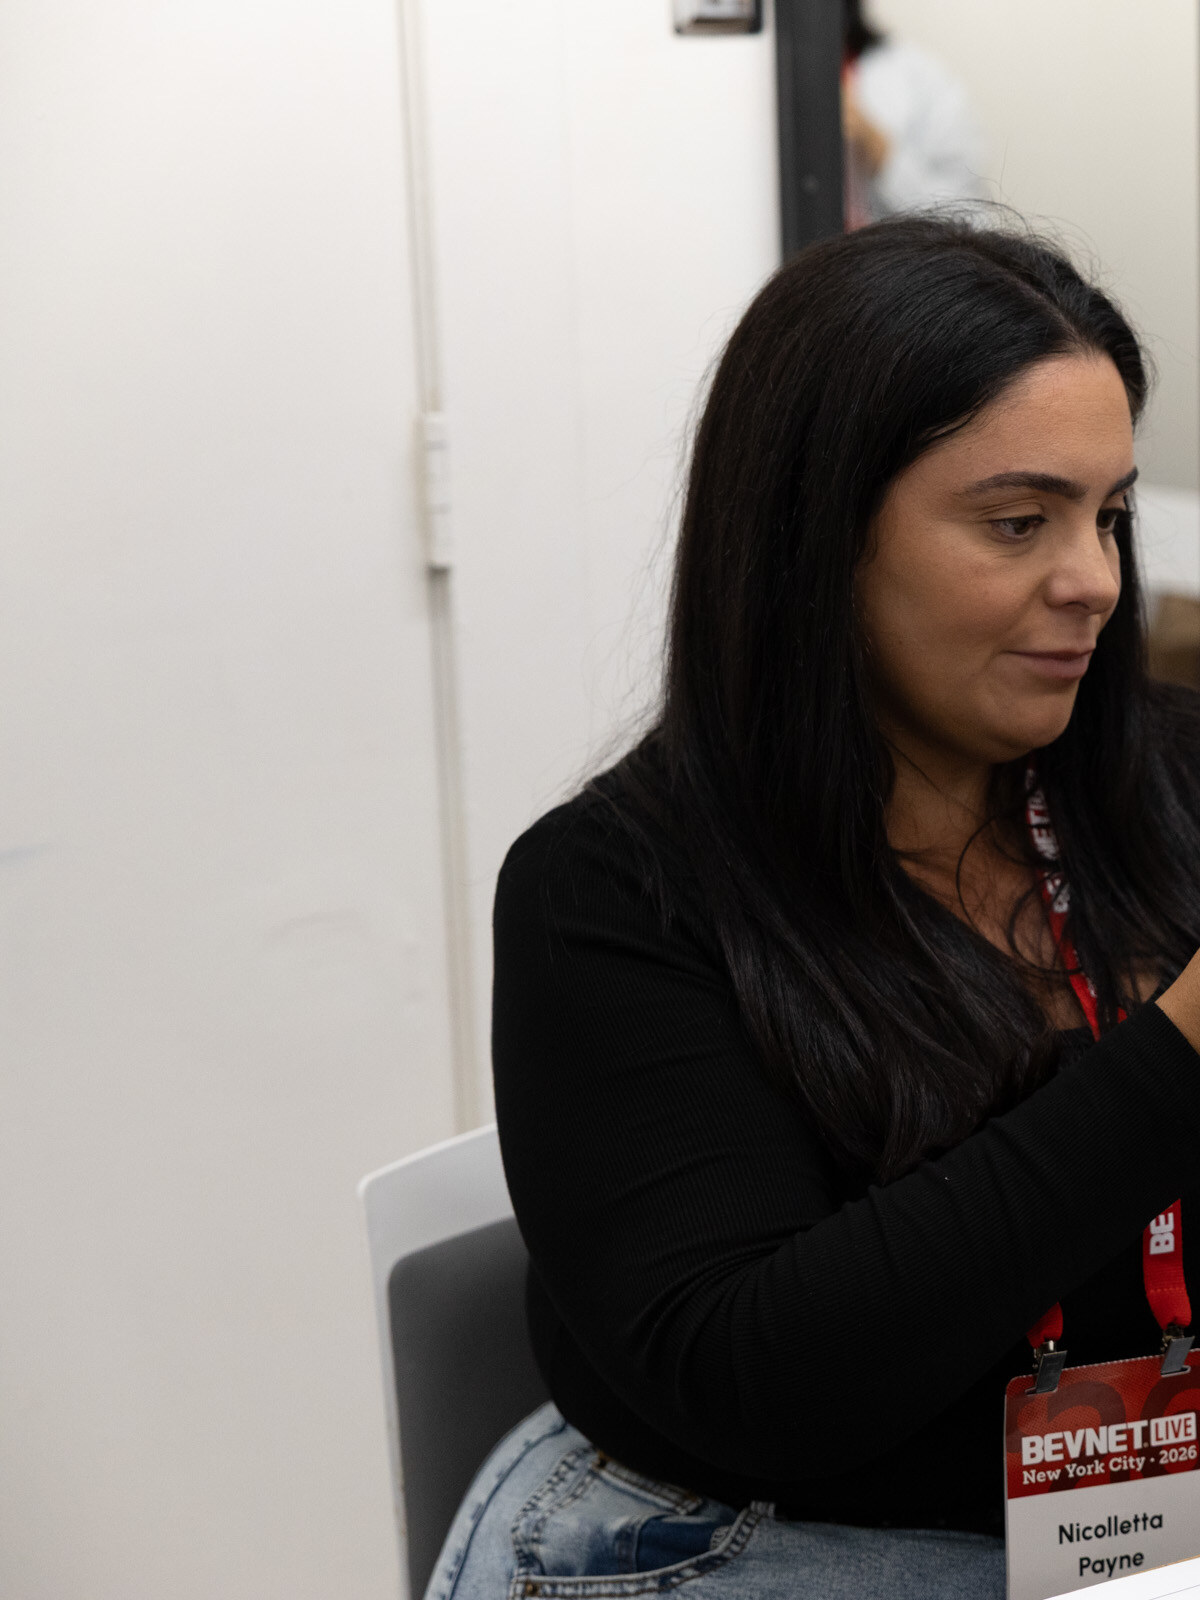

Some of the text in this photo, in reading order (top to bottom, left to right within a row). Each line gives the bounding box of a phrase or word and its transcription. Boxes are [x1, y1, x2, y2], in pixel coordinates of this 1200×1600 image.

[1149, 1212, 1175, 1255] BE
[1021, 1416, 1192, 1466] BEVNET LIVE
[1022, 1445, 1197, 1485] New York City 2026
[1058, 1512, 1163, 1545] Nicolletta
[1079, 1552, 1144, 1577] Payne
